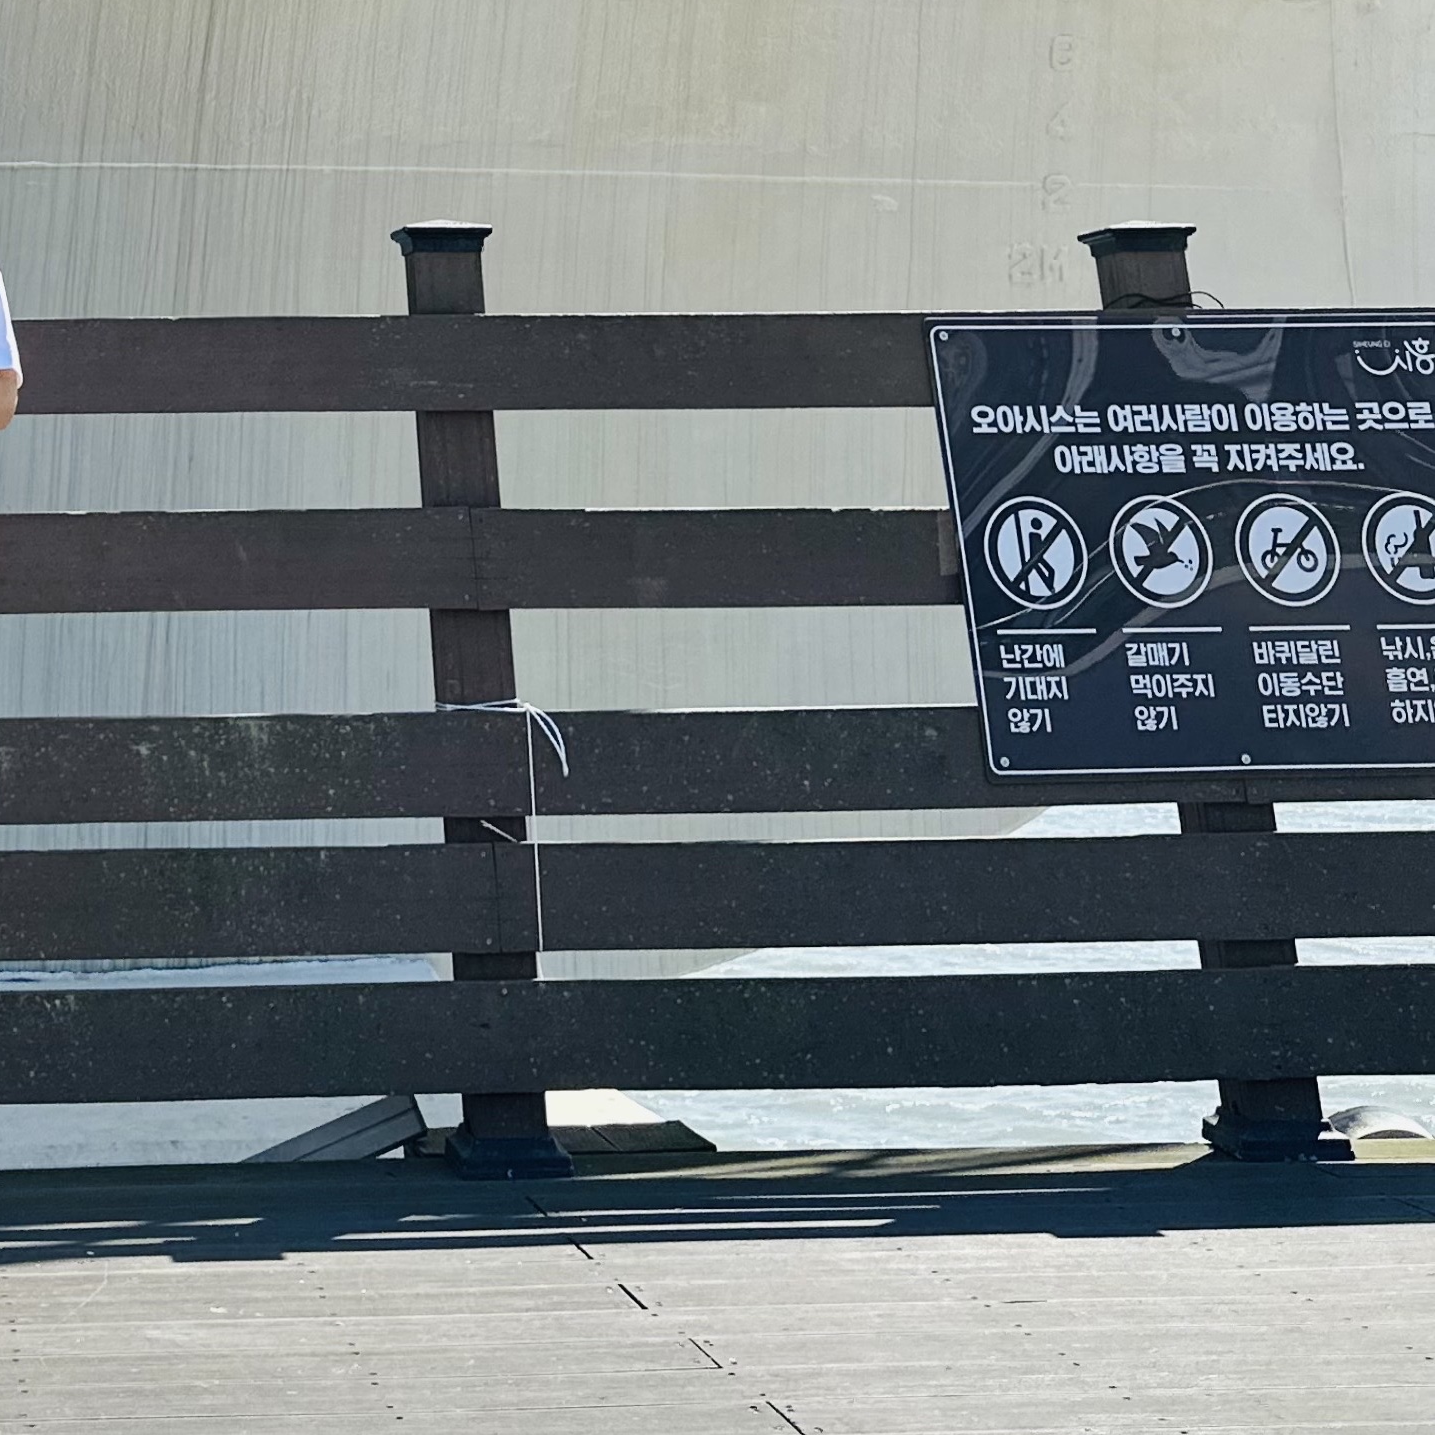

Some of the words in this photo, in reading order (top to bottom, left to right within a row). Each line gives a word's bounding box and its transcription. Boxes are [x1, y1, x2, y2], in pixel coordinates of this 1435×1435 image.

[970, 404, 1102, 434] 오아시스는
[1107, 403, 1239, 433] 여러사람이
[1244, 402, 1350, 432] 이용하는
[1354, 401, 1435, 431] 곳으로
[1054, 443, 1186, 474] 아래사항을
[1190, 444, 1219, 473] 꼭
[1224, 442, 1365, 472] 지켜주세요.
[999, 643, 1065, 669] 난간에
[1125, 642, 1190, 667] 갈매기
[1252, 639, 1341, 665] 바퀴달린
[1380, 635, 1435, 661] 낚시,
[1003, 675, 1069, 701] 기대지
[1130, 673, 1215, 699] 먹이주지
[1257, 671, 1344, 697] 이동수단
[1007, 707, 1052, 733] 않기
[1134, 705, 1178, 731] 않기
[1262, 703, 1350, 729] 타지않기
[1390, 699, 1435, 724] 하지
